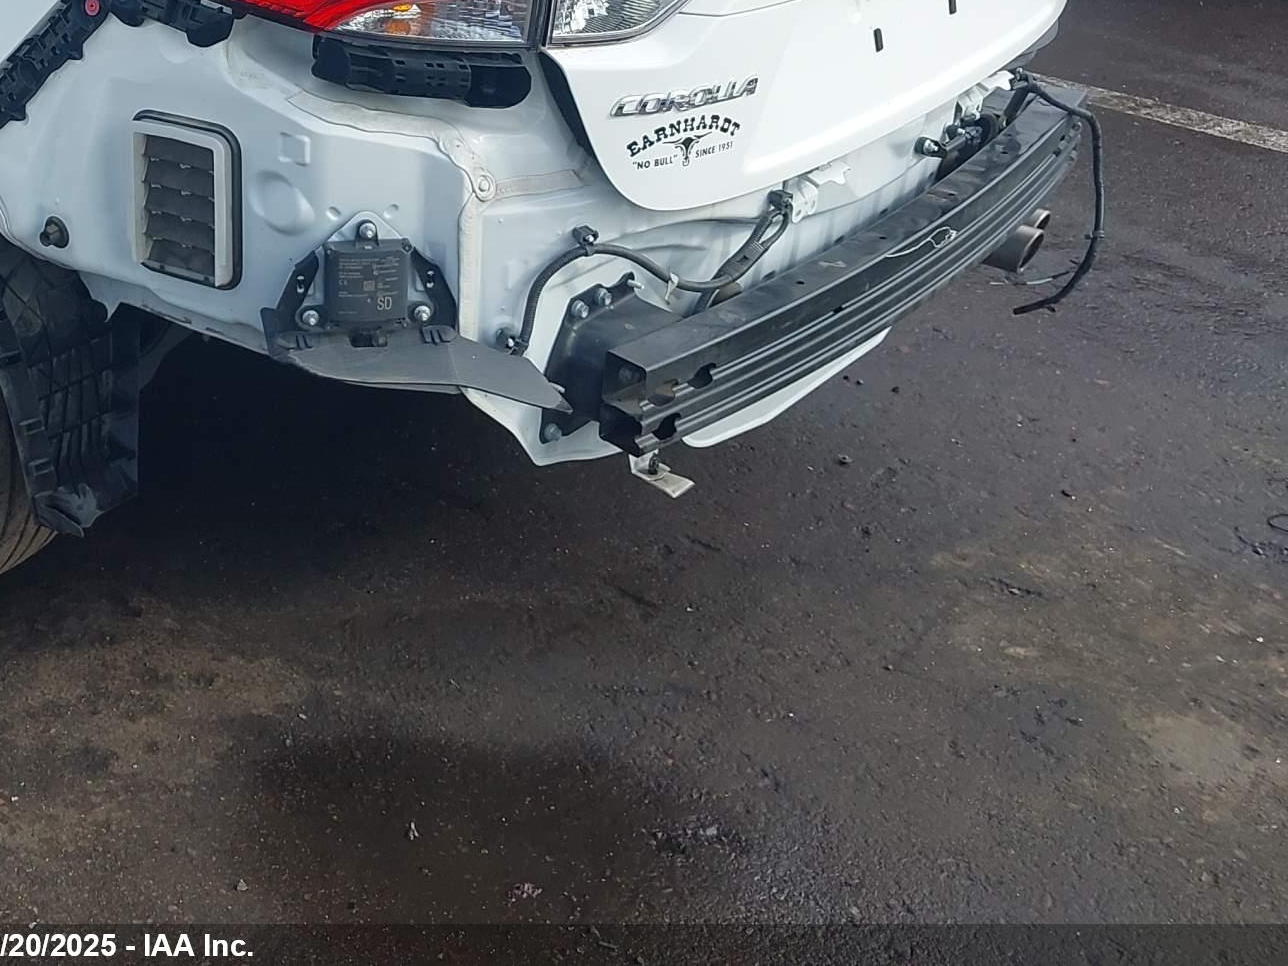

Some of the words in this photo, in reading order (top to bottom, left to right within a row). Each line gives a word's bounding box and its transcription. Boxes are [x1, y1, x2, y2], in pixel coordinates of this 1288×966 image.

[610, 75, 759, 116] COROLLA
[627, 114, 741, 157] EARNHARDT
[695, 146, 716, 159] SINCE
[718, 141, 733, 153] 1951
[377, 296, 393, 311] SD
